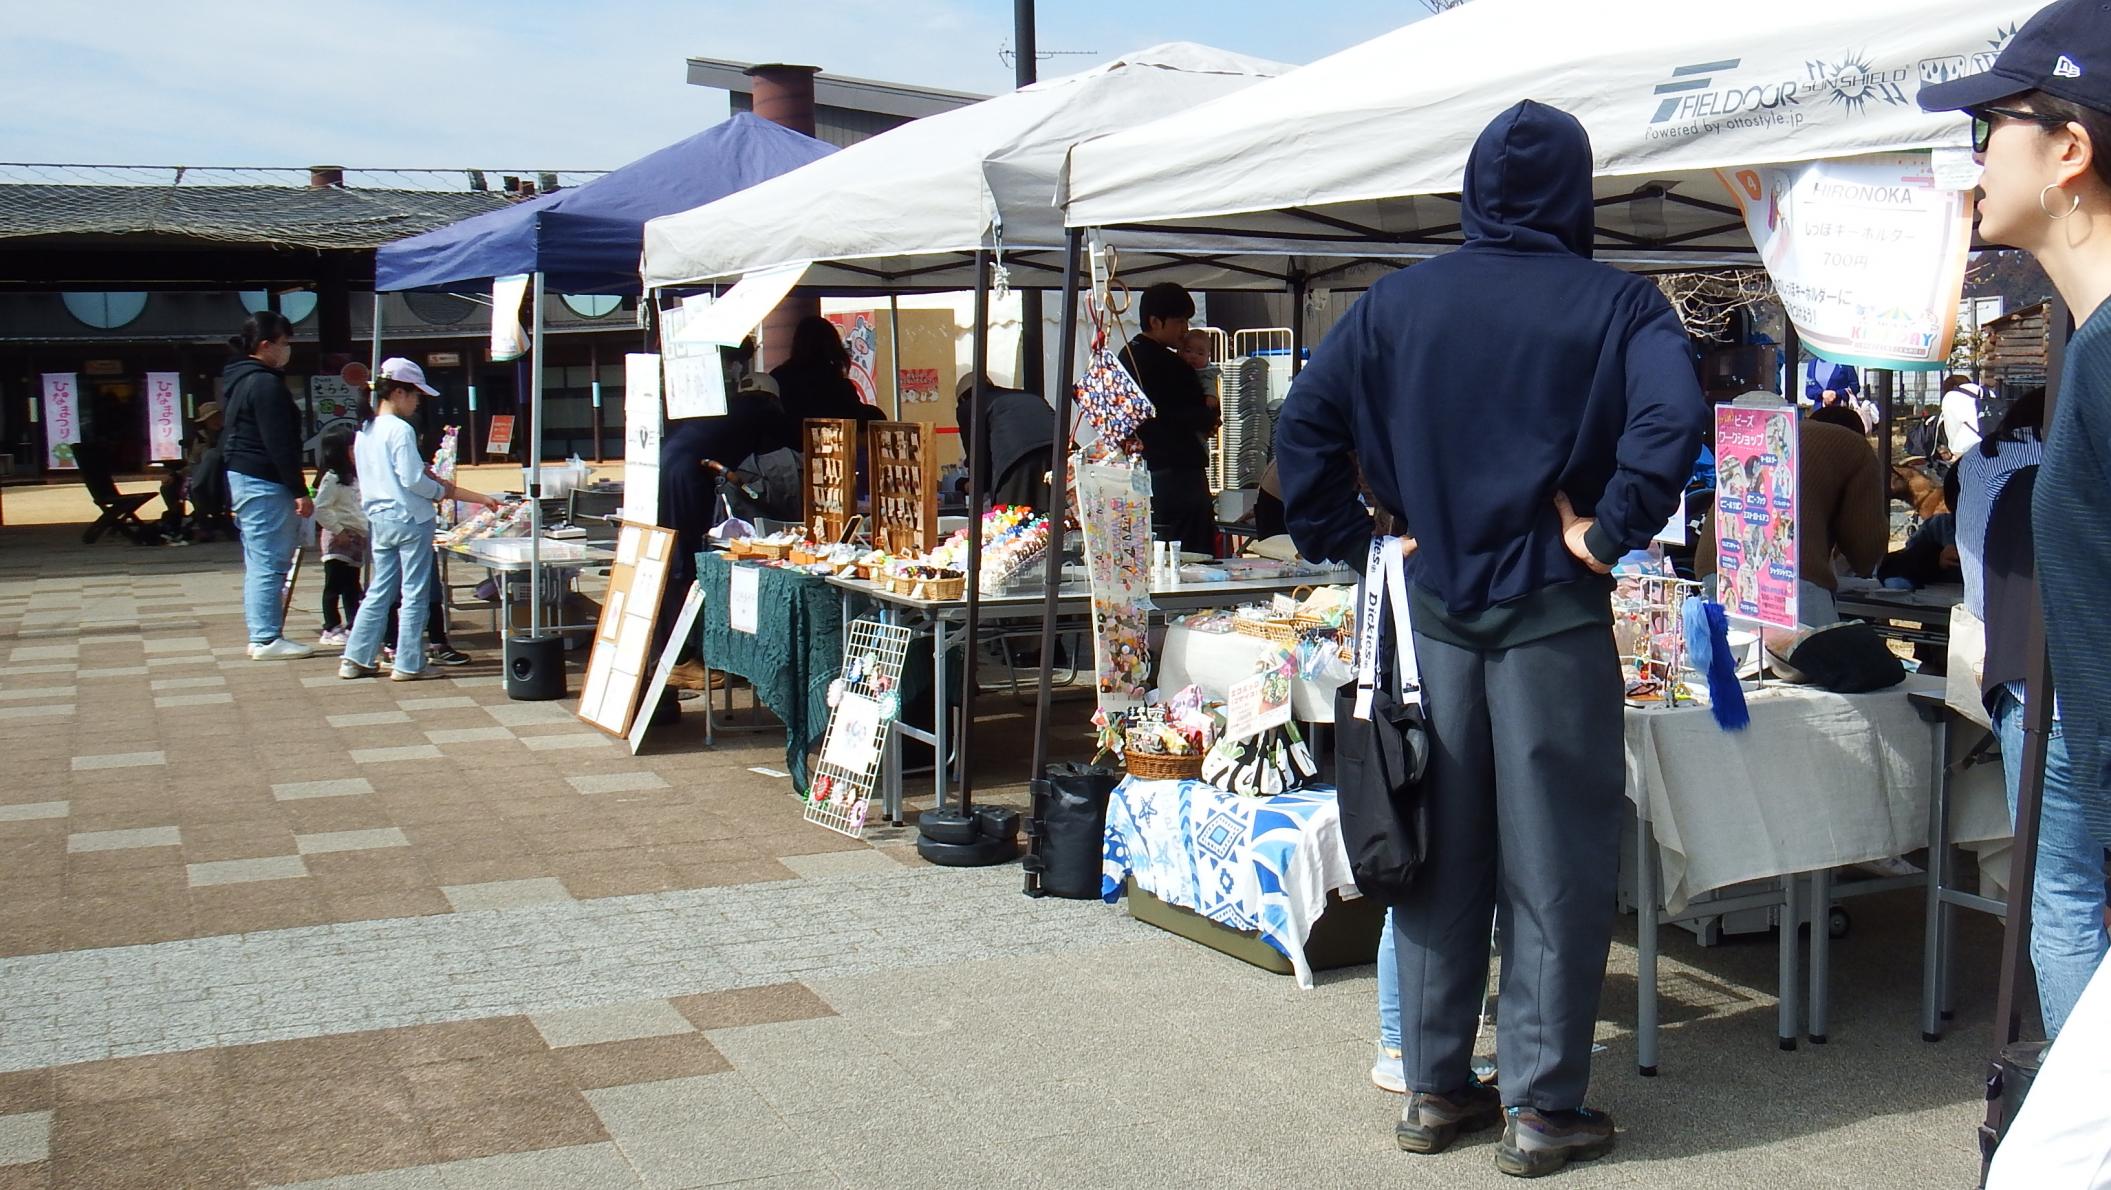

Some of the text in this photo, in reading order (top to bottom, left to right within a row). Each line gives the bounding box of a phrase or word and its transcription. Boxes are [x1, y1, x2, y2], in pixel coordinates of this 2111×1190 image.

[1645, 110, 1804, 141] Powered by ottostyle.jp
[1812, 182, 1912, 205] HIRONOKA
[1822, 251, 1869, 270] 700円
[52, 380, 72, 439] ひなまつり
[155, 380, 174, 438] ひなまつり
[1734, 414, 1754, 428] ビーズ
[1718, 431, 1765, 447] ワークショップ
[1363, 591, 1378, 663] Dickies
